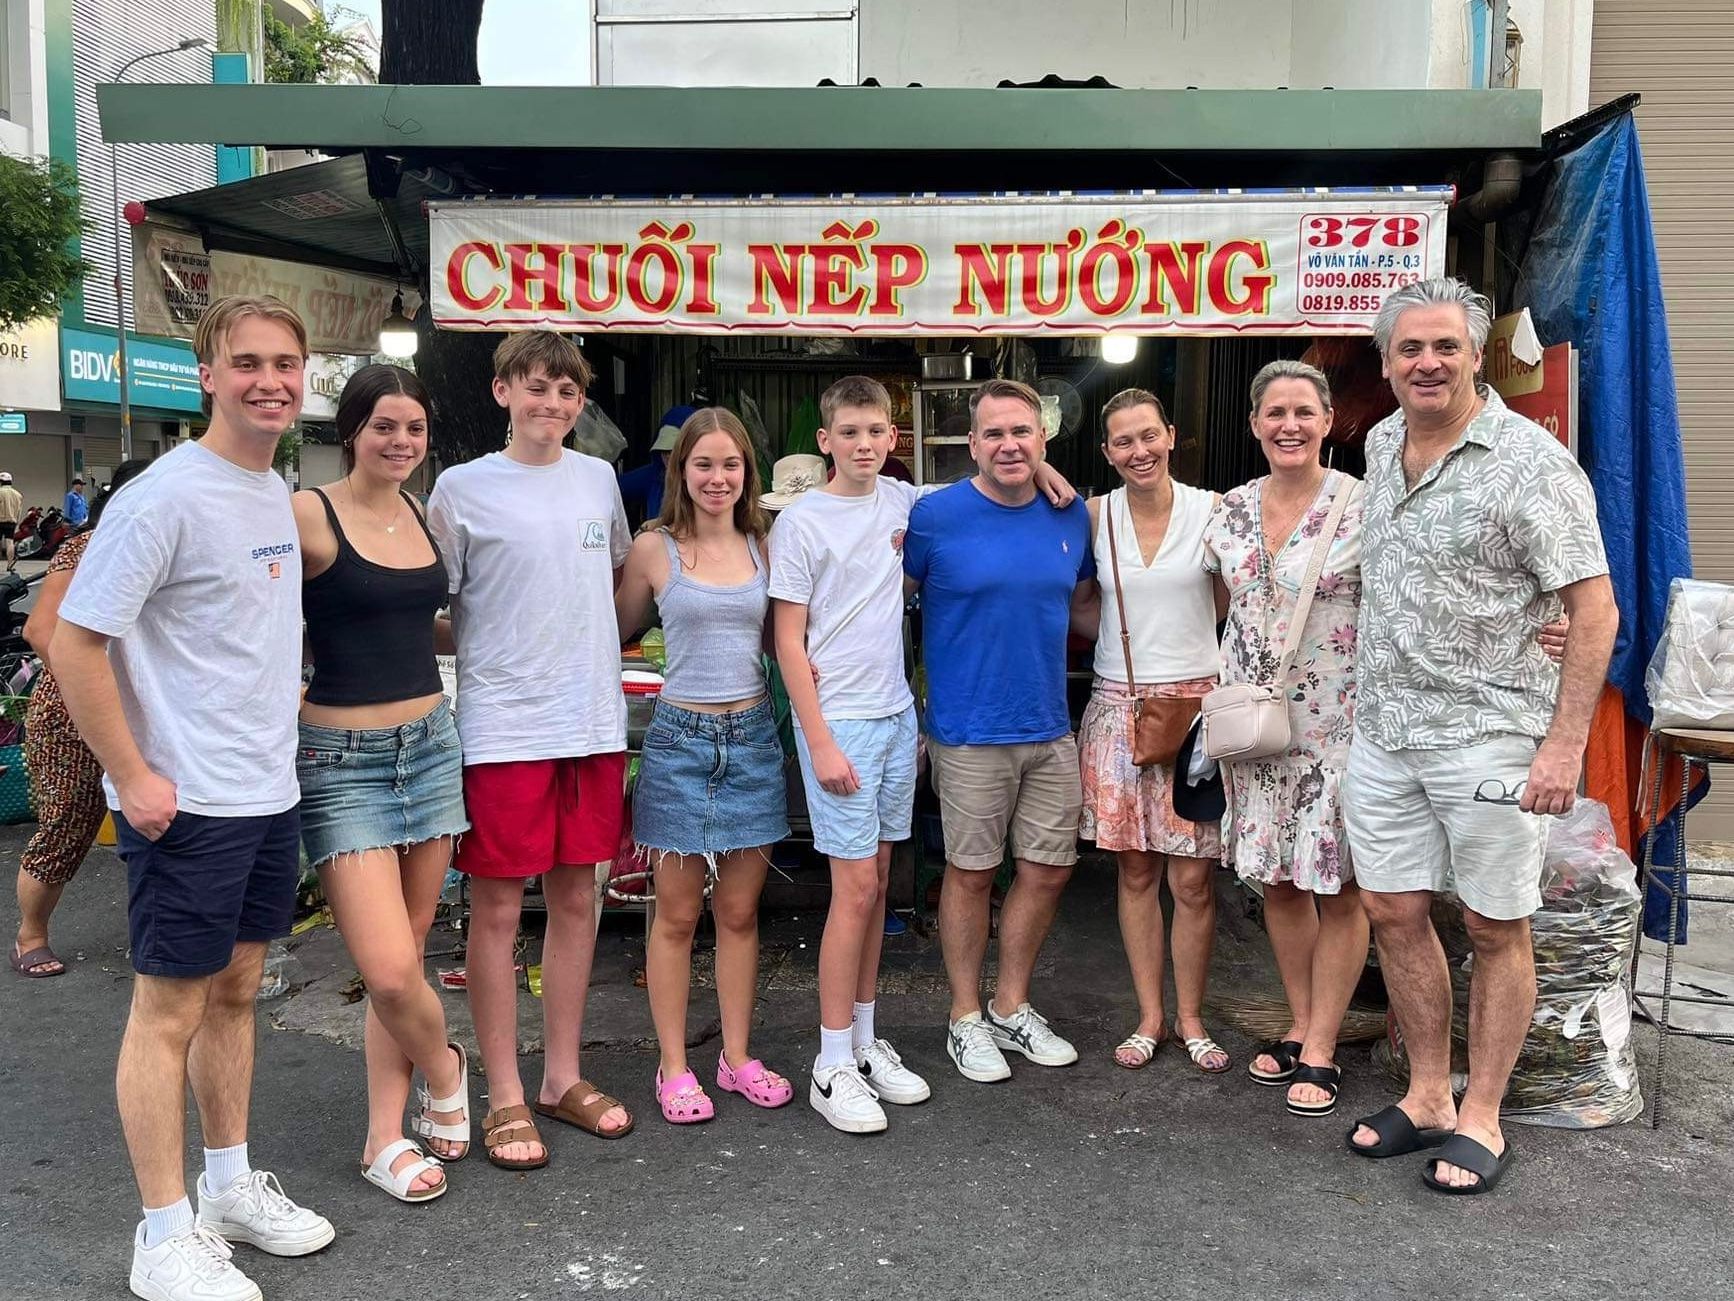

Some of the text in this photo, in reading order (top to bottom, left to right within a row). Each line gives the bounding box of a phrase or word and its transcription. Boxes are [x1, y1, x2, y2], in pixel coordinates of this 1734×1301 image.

[1308, 217, 1420, 248] 378
[446, 218, 722, 316] CHUỐI
[747, 218, 929, 317] NẾP
[953, 218, 1277, 319] NƯỚNG
[1378, 254, 1394, 268] P.5
[1403, 254, 1421, 269] Q.3
[1303, 272, 1420, 288] 0909.085.763
[70, 349, 114, 382] BIDV
[251, 543, 294, 560] SPENCER
